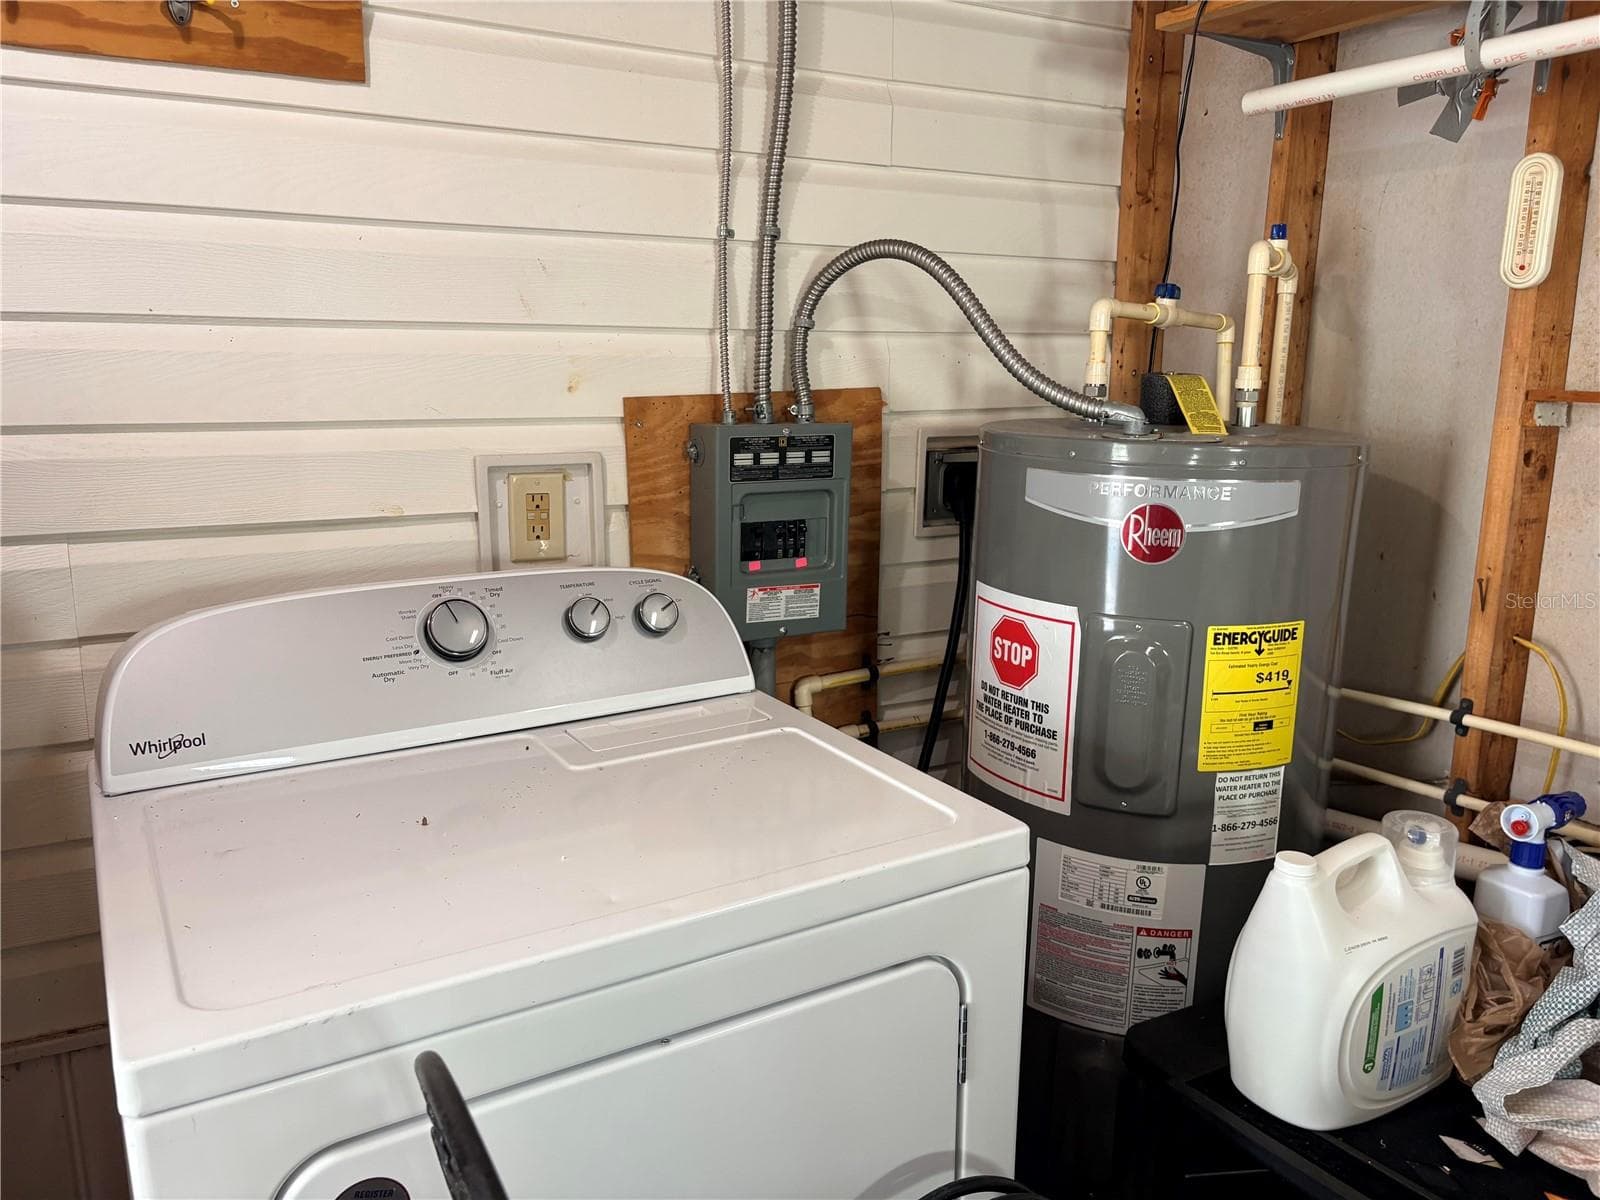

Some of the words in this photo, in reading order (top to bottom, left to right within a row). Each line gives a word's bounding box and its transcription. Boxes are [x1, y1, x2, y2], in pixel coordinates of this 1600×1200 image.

[1493, 52, 1528, 66] PIPE
[1090, 482, 1232, 501] PERFORMANCE
[1128, 504, 1181, 554] Rheem
[560, 582, 596, 590] TEMPERATURE
[994, 636, 1032, 668] STOP
[372, 670, 406, 678] Automatic
[980, 680, 988, 690] DO
[988, 684, 1000, 697] NOT
[1001, 690, 1028, 709] RETURN
[1030, 700, 1050, 714] THIS
[984, 692, 1002, 710] WATER
[1003, 703, 1030, 721] HEATER
[1032, 712, 1044, 724] TO
[976, 700, 984, 713] THE
[985, 704, 1002, 722] PLACE
[1004, 714, 1012, 726] OF
[1014, 718, 1058, 740] PURCHASE
[129, 732, 206, 757] Whirlpool
[984, 729, 1037, 760] 1-866-279-4566
[1244, 772, 1268, 781] RETURN
[1248, 789, 1278, 799] PURCHASE
[1211, 816, 1279, 833] 1-866-279-4566
[354, 1190, 394, 1199] REGISTER
